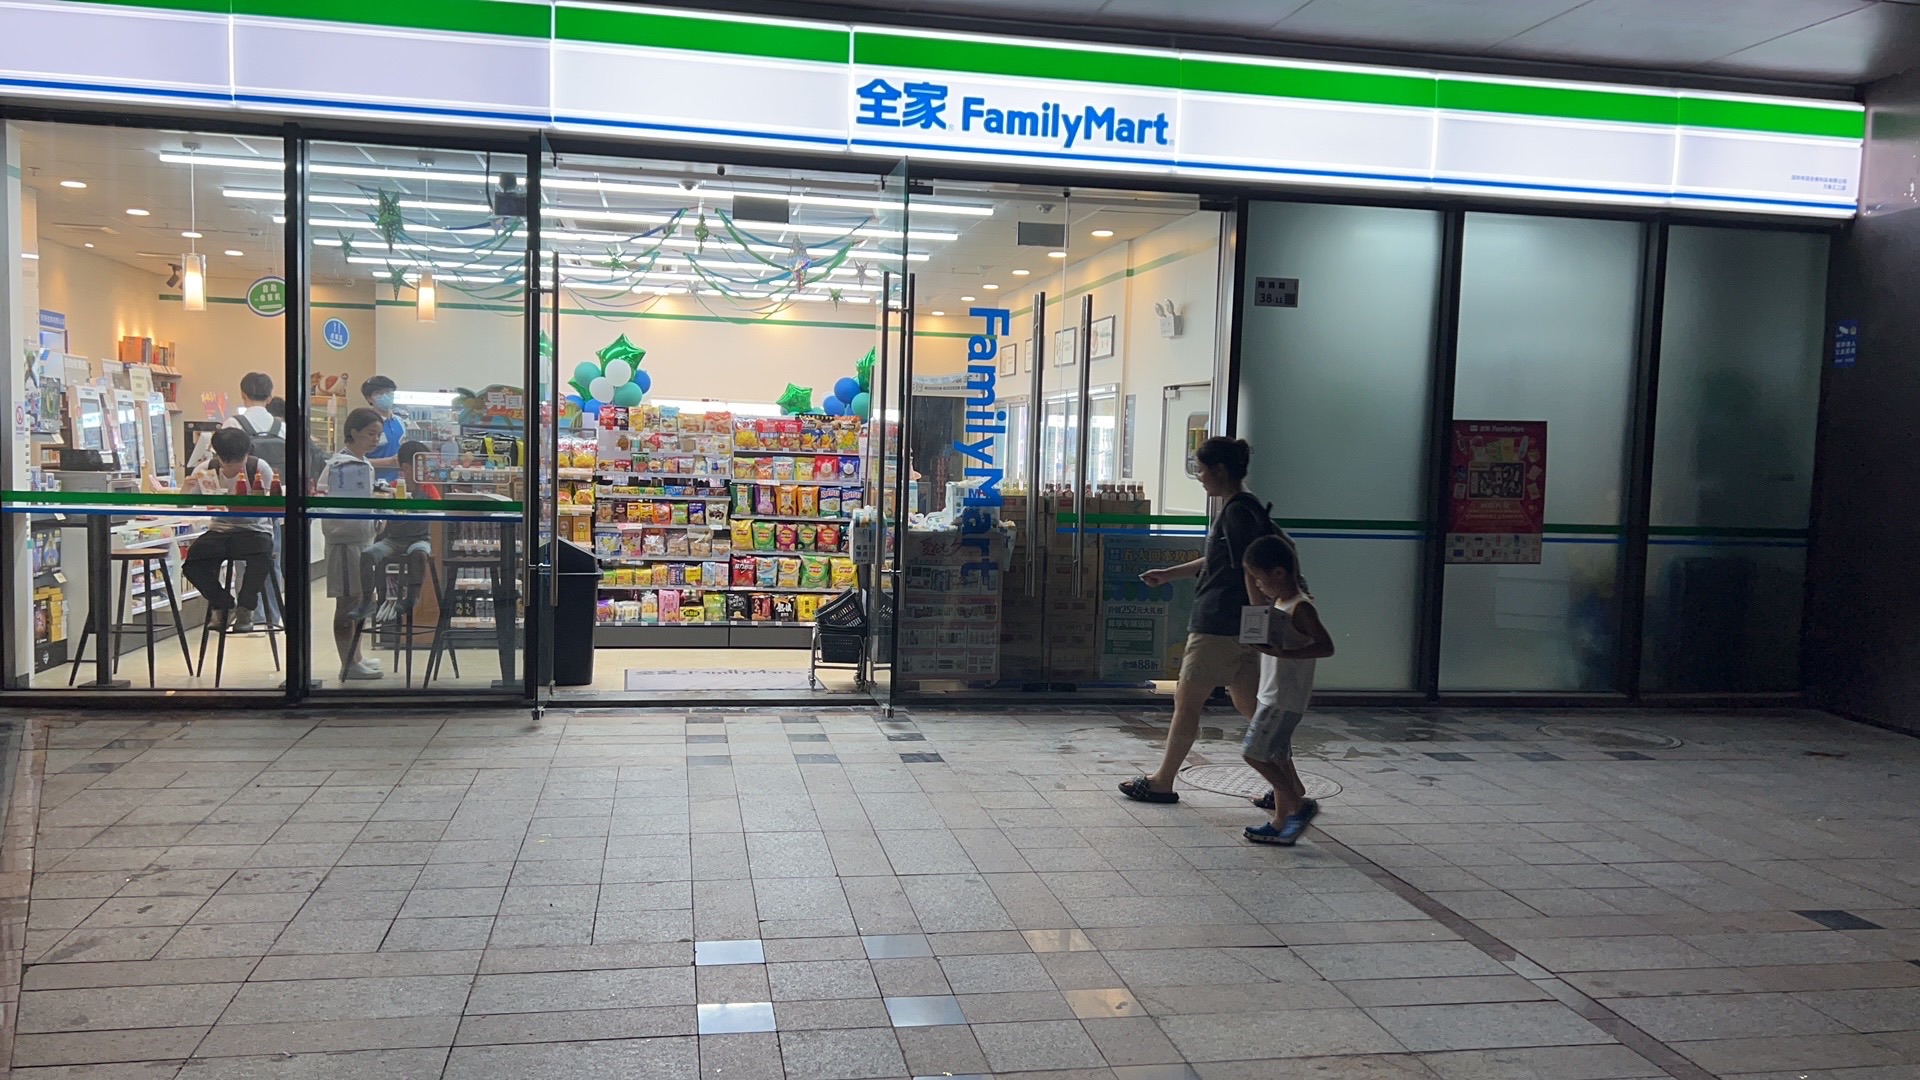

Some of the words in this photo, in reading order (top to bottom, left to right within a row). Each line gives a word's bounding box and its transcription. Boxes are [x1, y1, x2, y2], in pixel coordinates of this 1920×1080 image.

[856, 78, 948, 130] 全家
[961, 96, 1169, 149] FamilyMart
[952, 307, 1010, 584] FamilyMart
